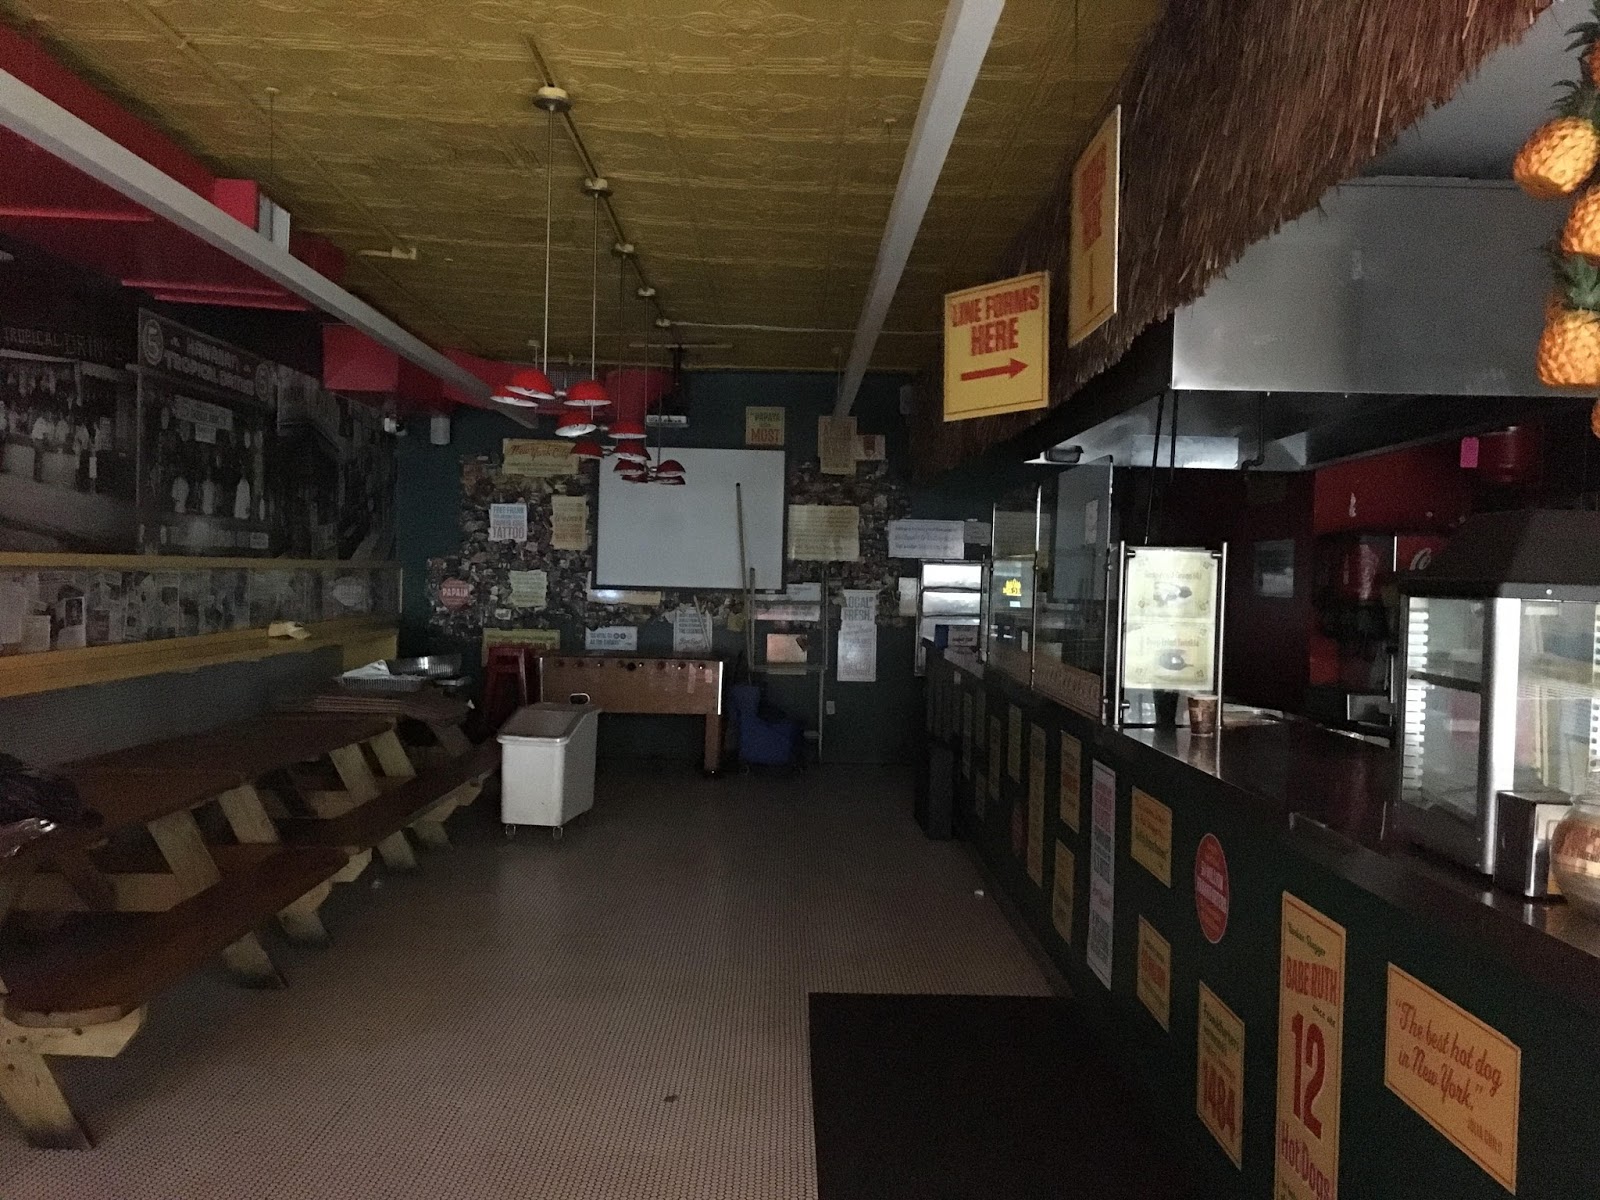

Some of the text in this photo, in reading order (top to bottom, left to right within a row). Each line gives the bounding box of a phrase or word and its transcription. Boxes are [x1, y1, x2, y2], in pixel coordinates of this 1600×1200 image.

[951, 285, 1040, 328] LINE FORMS
[971, 317, 1018, 356] HERE
[751, 428, 780, 442] MOST
[493, 526, 525, 539] TATTOO
[1286, 954, 1338, 1007] BABE RUTH
[1291, 1010, 1326, 1140] 12
[1398, 1050, 1411, 1069] in
[1412, 1045, 1438, 1087] New
[1425, 1019, 1450, 1055] best
[1450, 1031, 1475, 1070] hot
[1475, 1048, 1503, 1098] dog
[1280, 1120, 1300, 1174] Hot
[1300, 1140, 1331, 1200] Dogs
